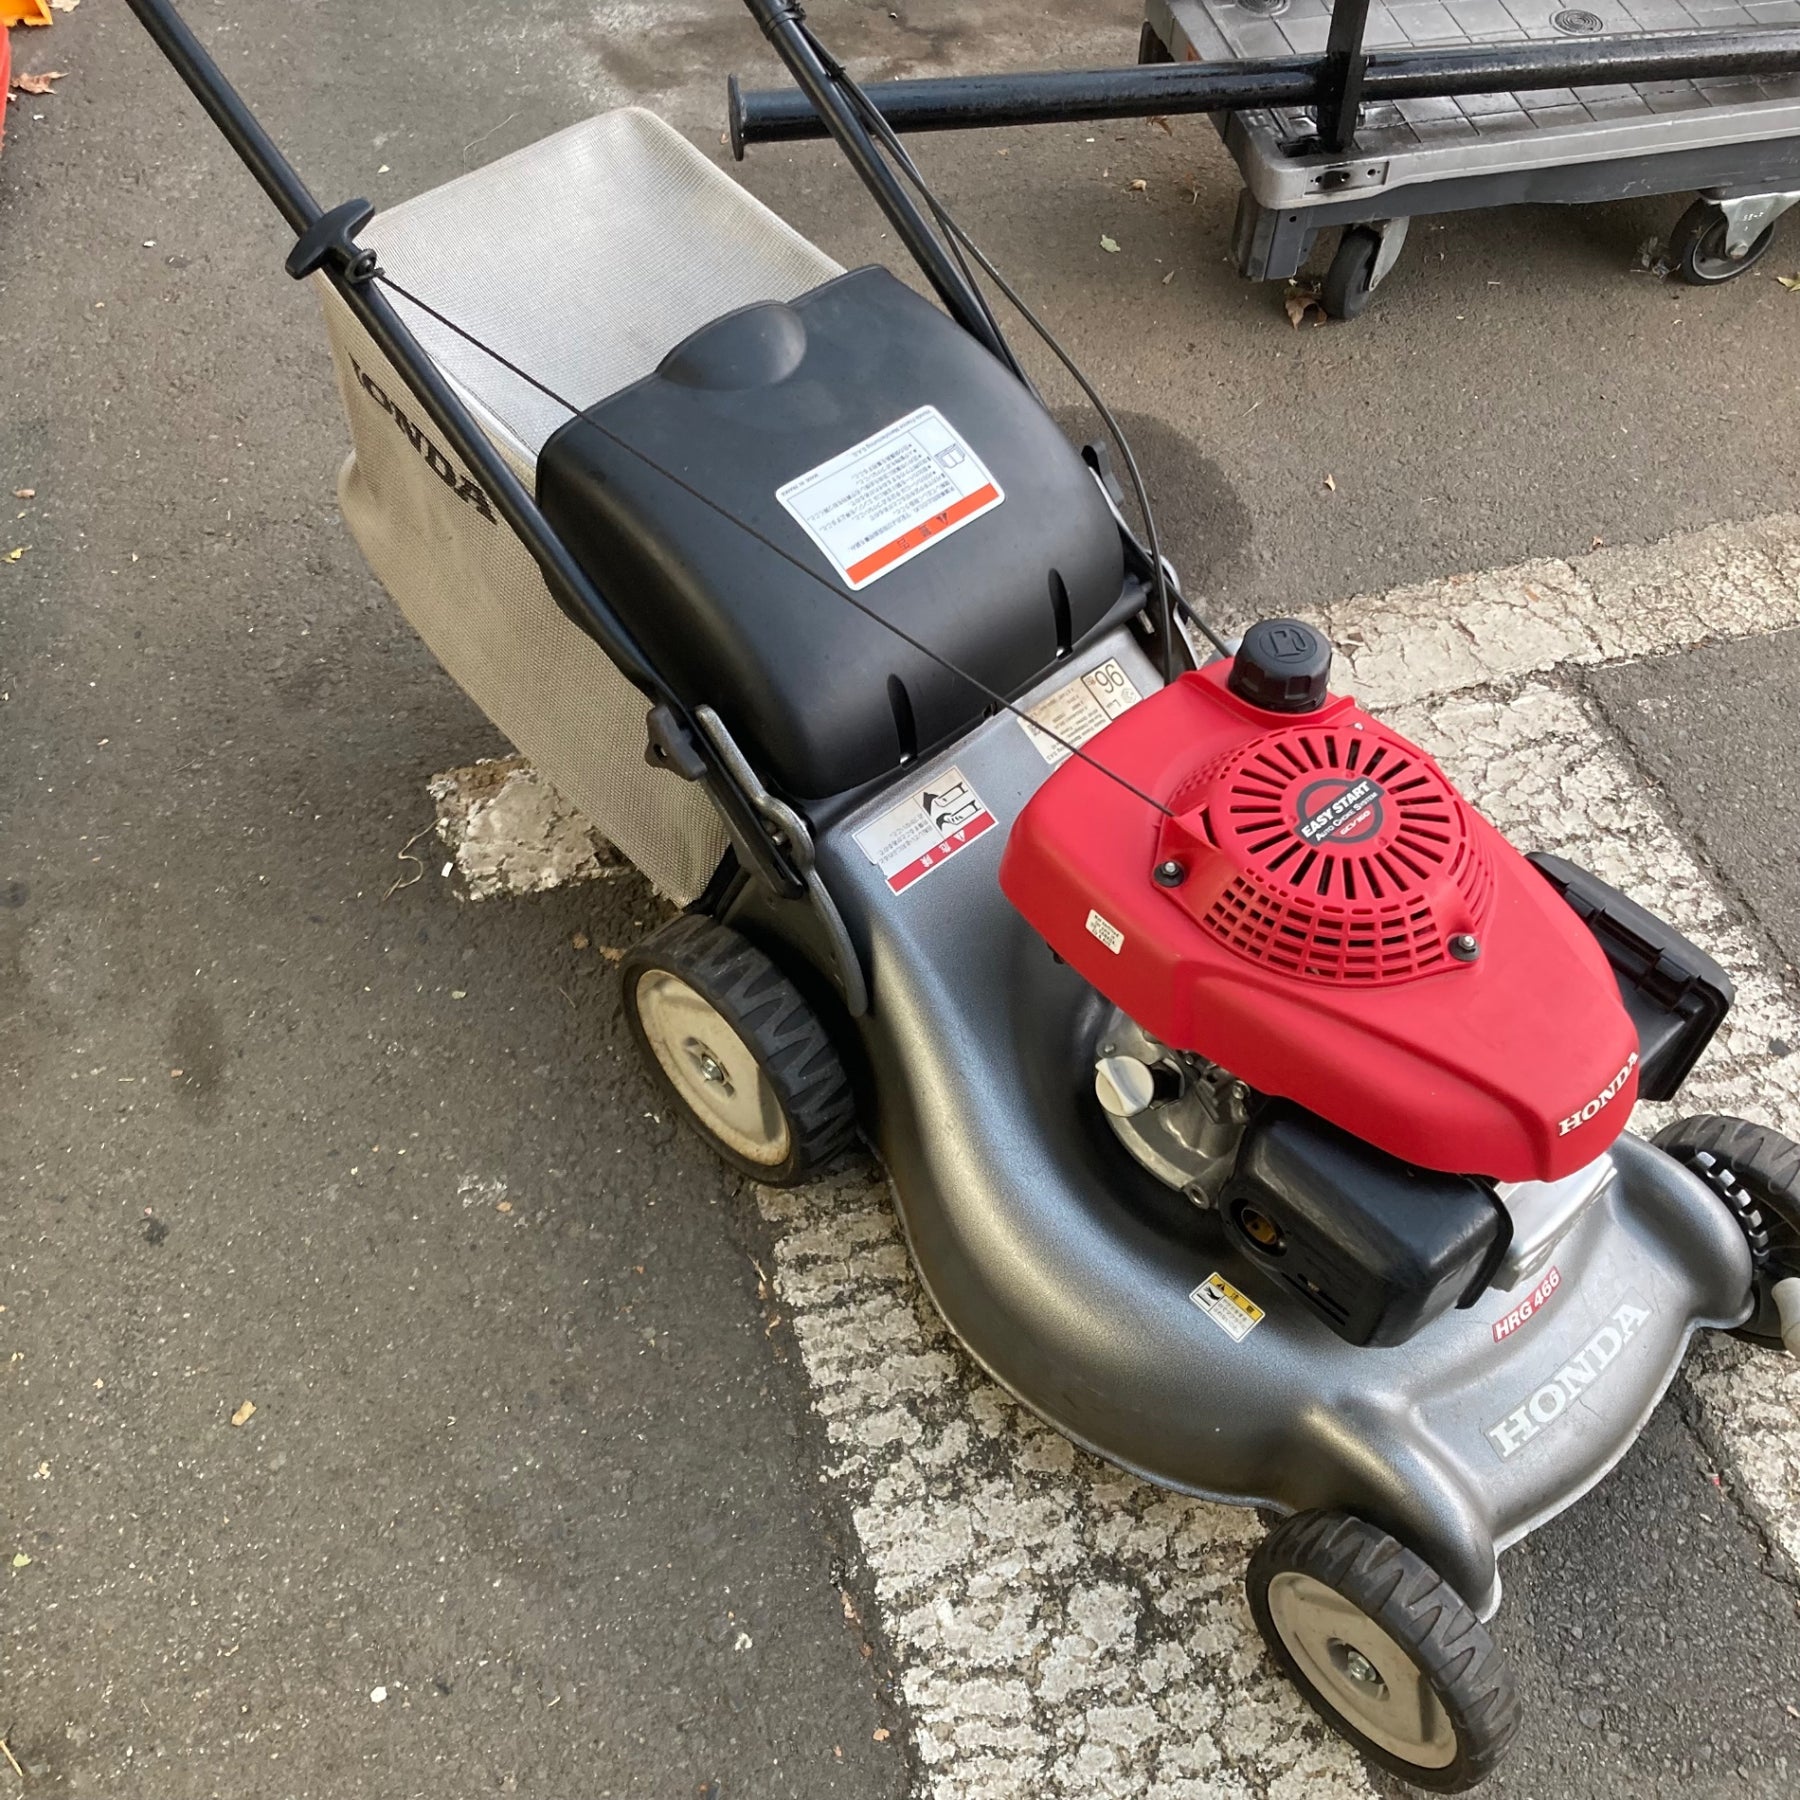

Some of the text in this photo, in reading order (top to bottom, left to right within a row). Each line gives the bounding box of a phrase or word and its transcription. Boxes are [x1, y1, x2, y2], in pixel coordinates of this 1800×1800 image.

[1094, 664, 1125, 694] 96
[1301, 781, 1370, 838] EASY START
[919, 842, 951, 867] 危険
[1559, 1052, 1638, 1136] HONDA
[1495, 1270, 1559, 1340] HRG 466
[1489, 1303, 1650, 1457] HONDA
